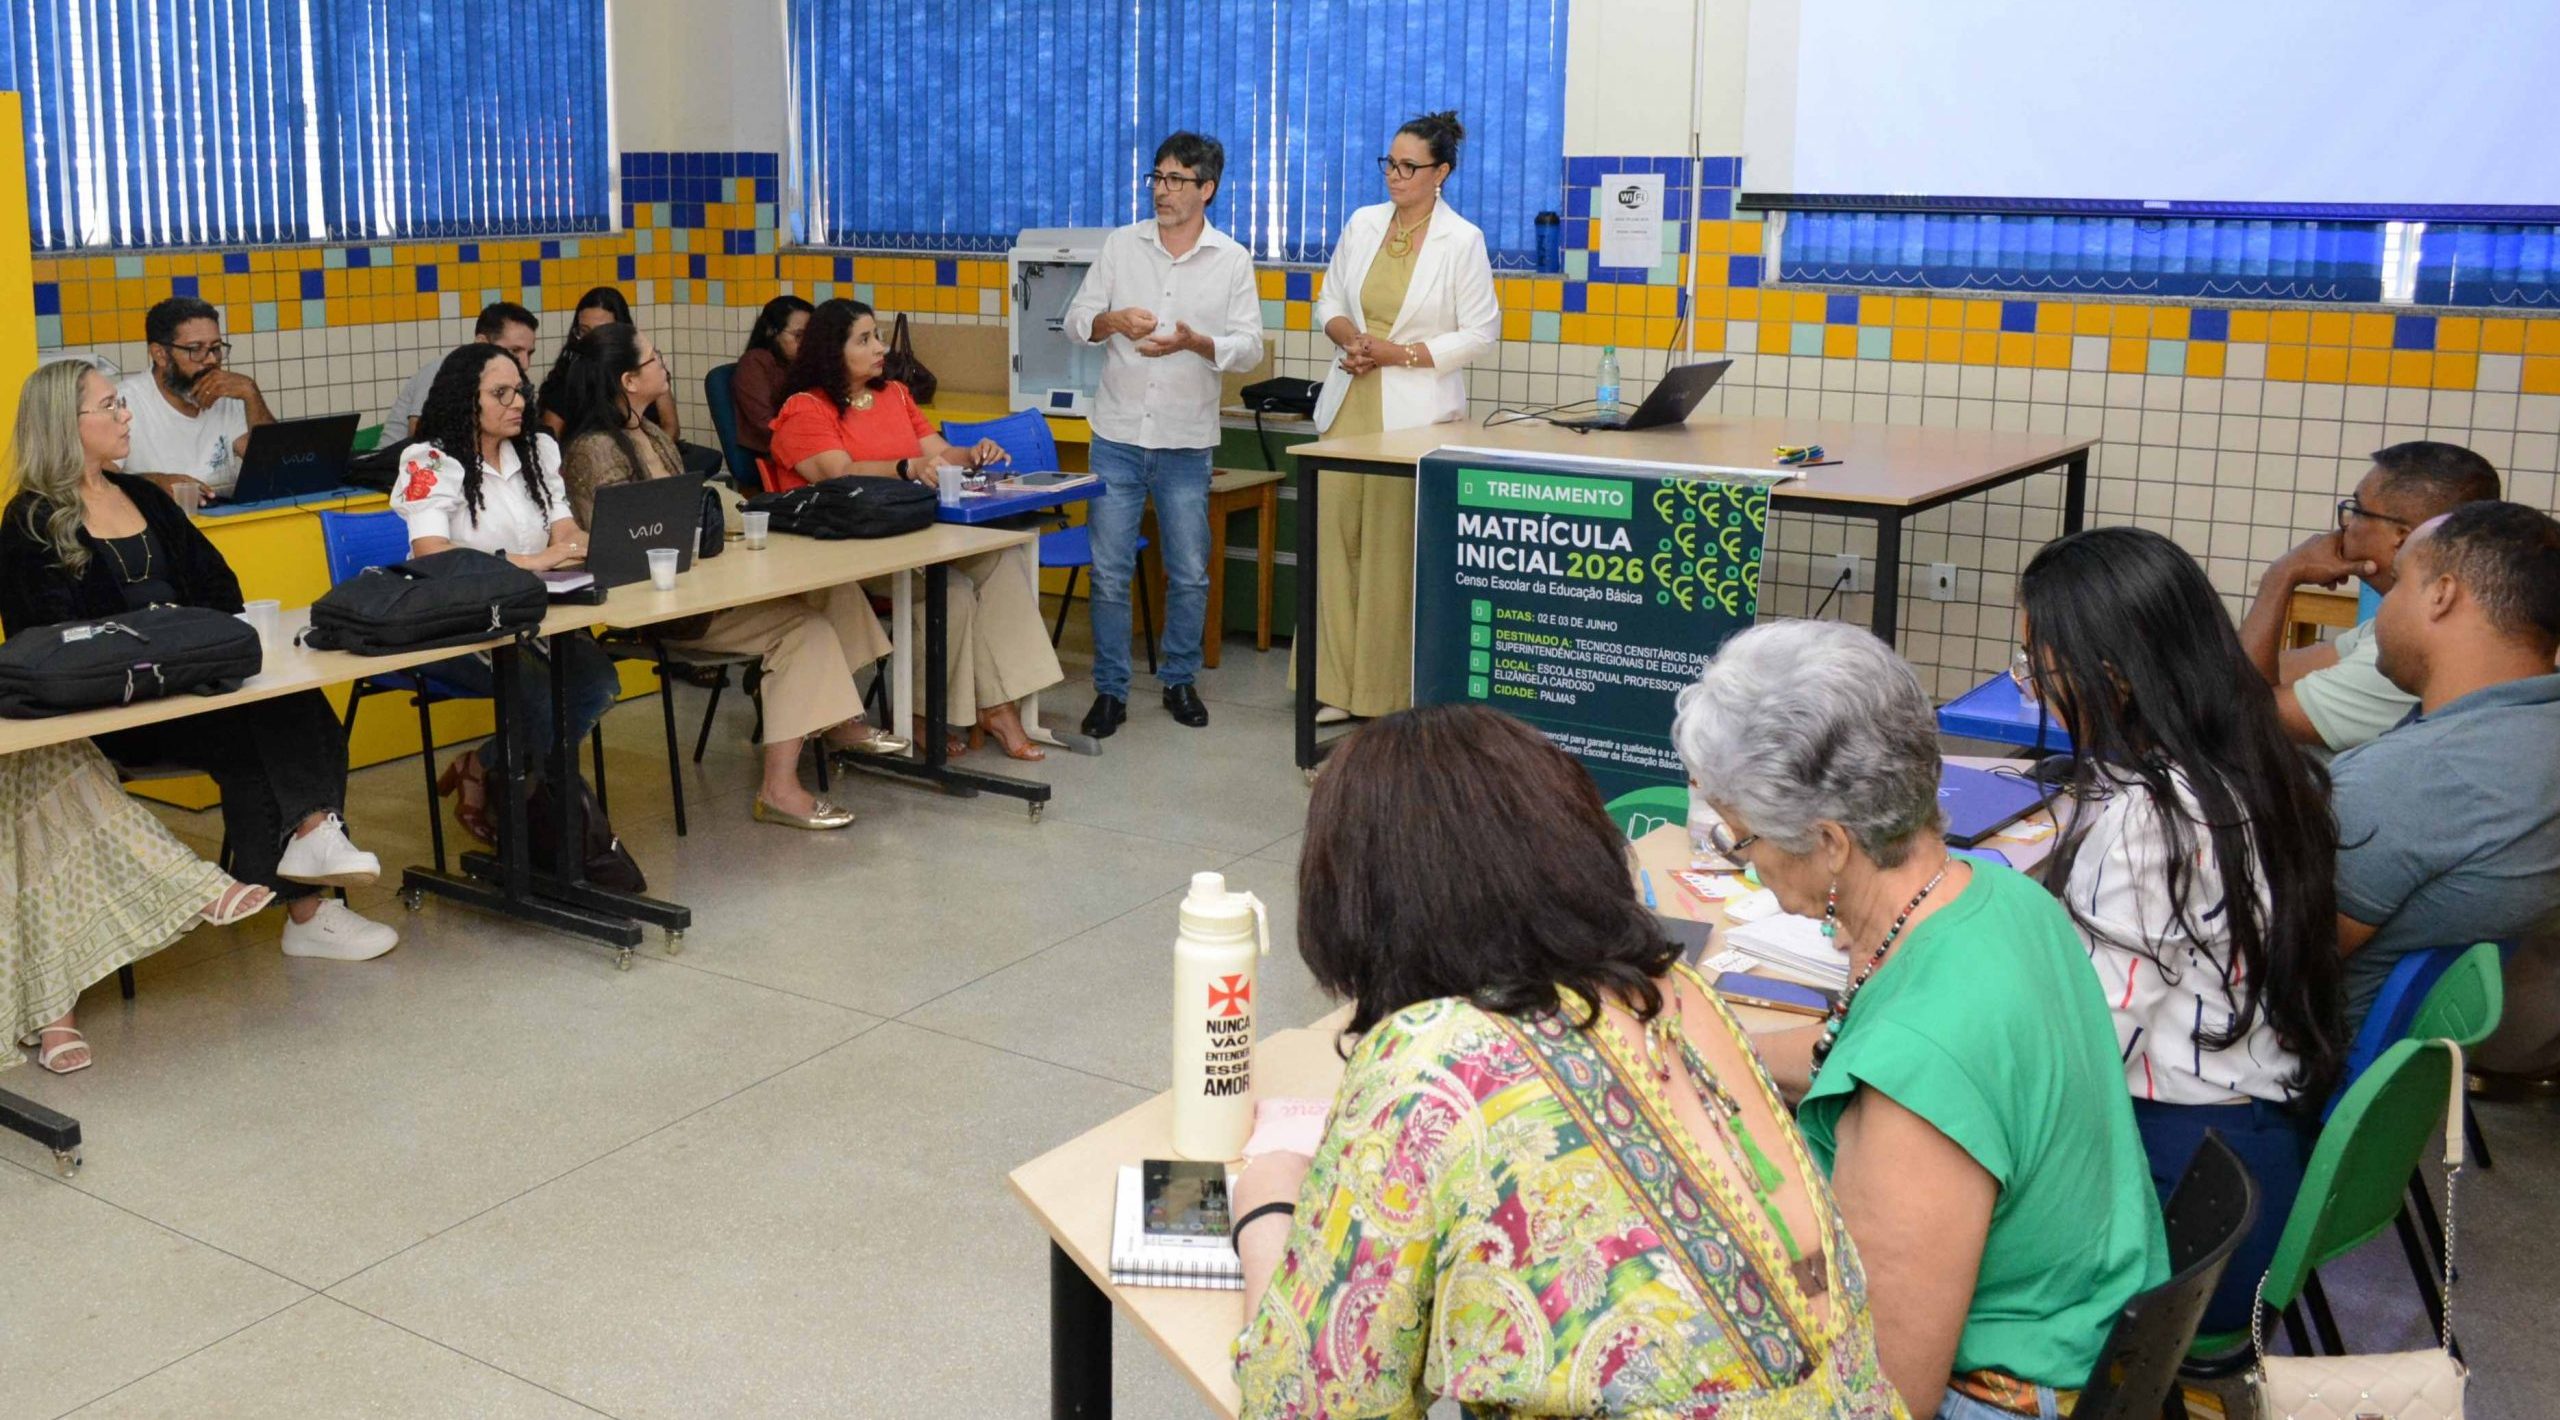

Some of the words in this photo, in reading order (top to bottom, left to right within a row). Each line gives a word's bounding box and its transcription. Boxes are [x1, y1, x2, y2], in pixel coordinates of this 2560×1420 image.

[1487, 481, 1624, 506] TREINAMENTO
[628, 521, 663, 540] VAIO
[1457, 512, 1632, 552] MATRÍCULA
[1457, 543, 1564, 576] INICIAL
[1566, 551, 1644, 584] 2026
[1455, 571, 1488, 587] Censo
[1490, 575, 1530, 592] Escolar
[1532, 580, 1546, 594] da
[1549, 582, 1603, 602] Educação
[1605, 587, 1643, 605] Básica
[1496, 608, 1535, 622] DATAS:
[1537, 612, 1549, 624] 02
[1549, 614, 1557, 625] E
[1558, 615, 1569, 627] 03
[1570, 617, 1584, 628] DE
[1585, 618, 1618, 632] JUNHO
[1496, 629, 1559, 646] DESTINADO
[1560, 637, 1573, 649] A:
[1624, 645, 1687, 663] CENSITÁRIOS
[1689, 653, 1710, 665] DAS
[1495, 640, 1592, 663] SUPERINTENDÊNCIAS
[1593, 653, 1644, 670] REGIONAIS
[1646, 660, 1659, 672] DE
[1661, 662, 1704, 679] EDUCAÇ
[1495, 658, 1535, 672] LOCAL:
[1537, 663, 1574, 677] ESCOLA
[1575, 668, 1622, 684] ESTADUAL
[1494, 669, 1548, 686] ELIZÂNGELA
[1549, 677, 1595, 692] CARDOSO
[1494, 684, 1538, 699] CIDADE:
[1540, 690, 1576, 705] PALMAS
[1559, 742, 1582, 754] Censo
[1583, 746, 1609, 759] Escolar
[1610, 751, 1620, 761] da
[1622, 752, 1657, 767] Educação
[1570, 734, 1586, 745] para
[1587, 737, 1614, 750] garantir
[1622, 743, 1657, 756] qualidade
[1657, 748, 1663, 756] e
[1664, 749, 1670, 758] a
[1206, 1015, 1250, 1034] NUNCA
[1211, 1034, 1248, 1047] VÃO
[1205, 1047, 1250, 1062] ENTENDER
[1205, 1060, 1250, 1076] ESSE
[1203, 1073, 1250, 1096] AMOR
